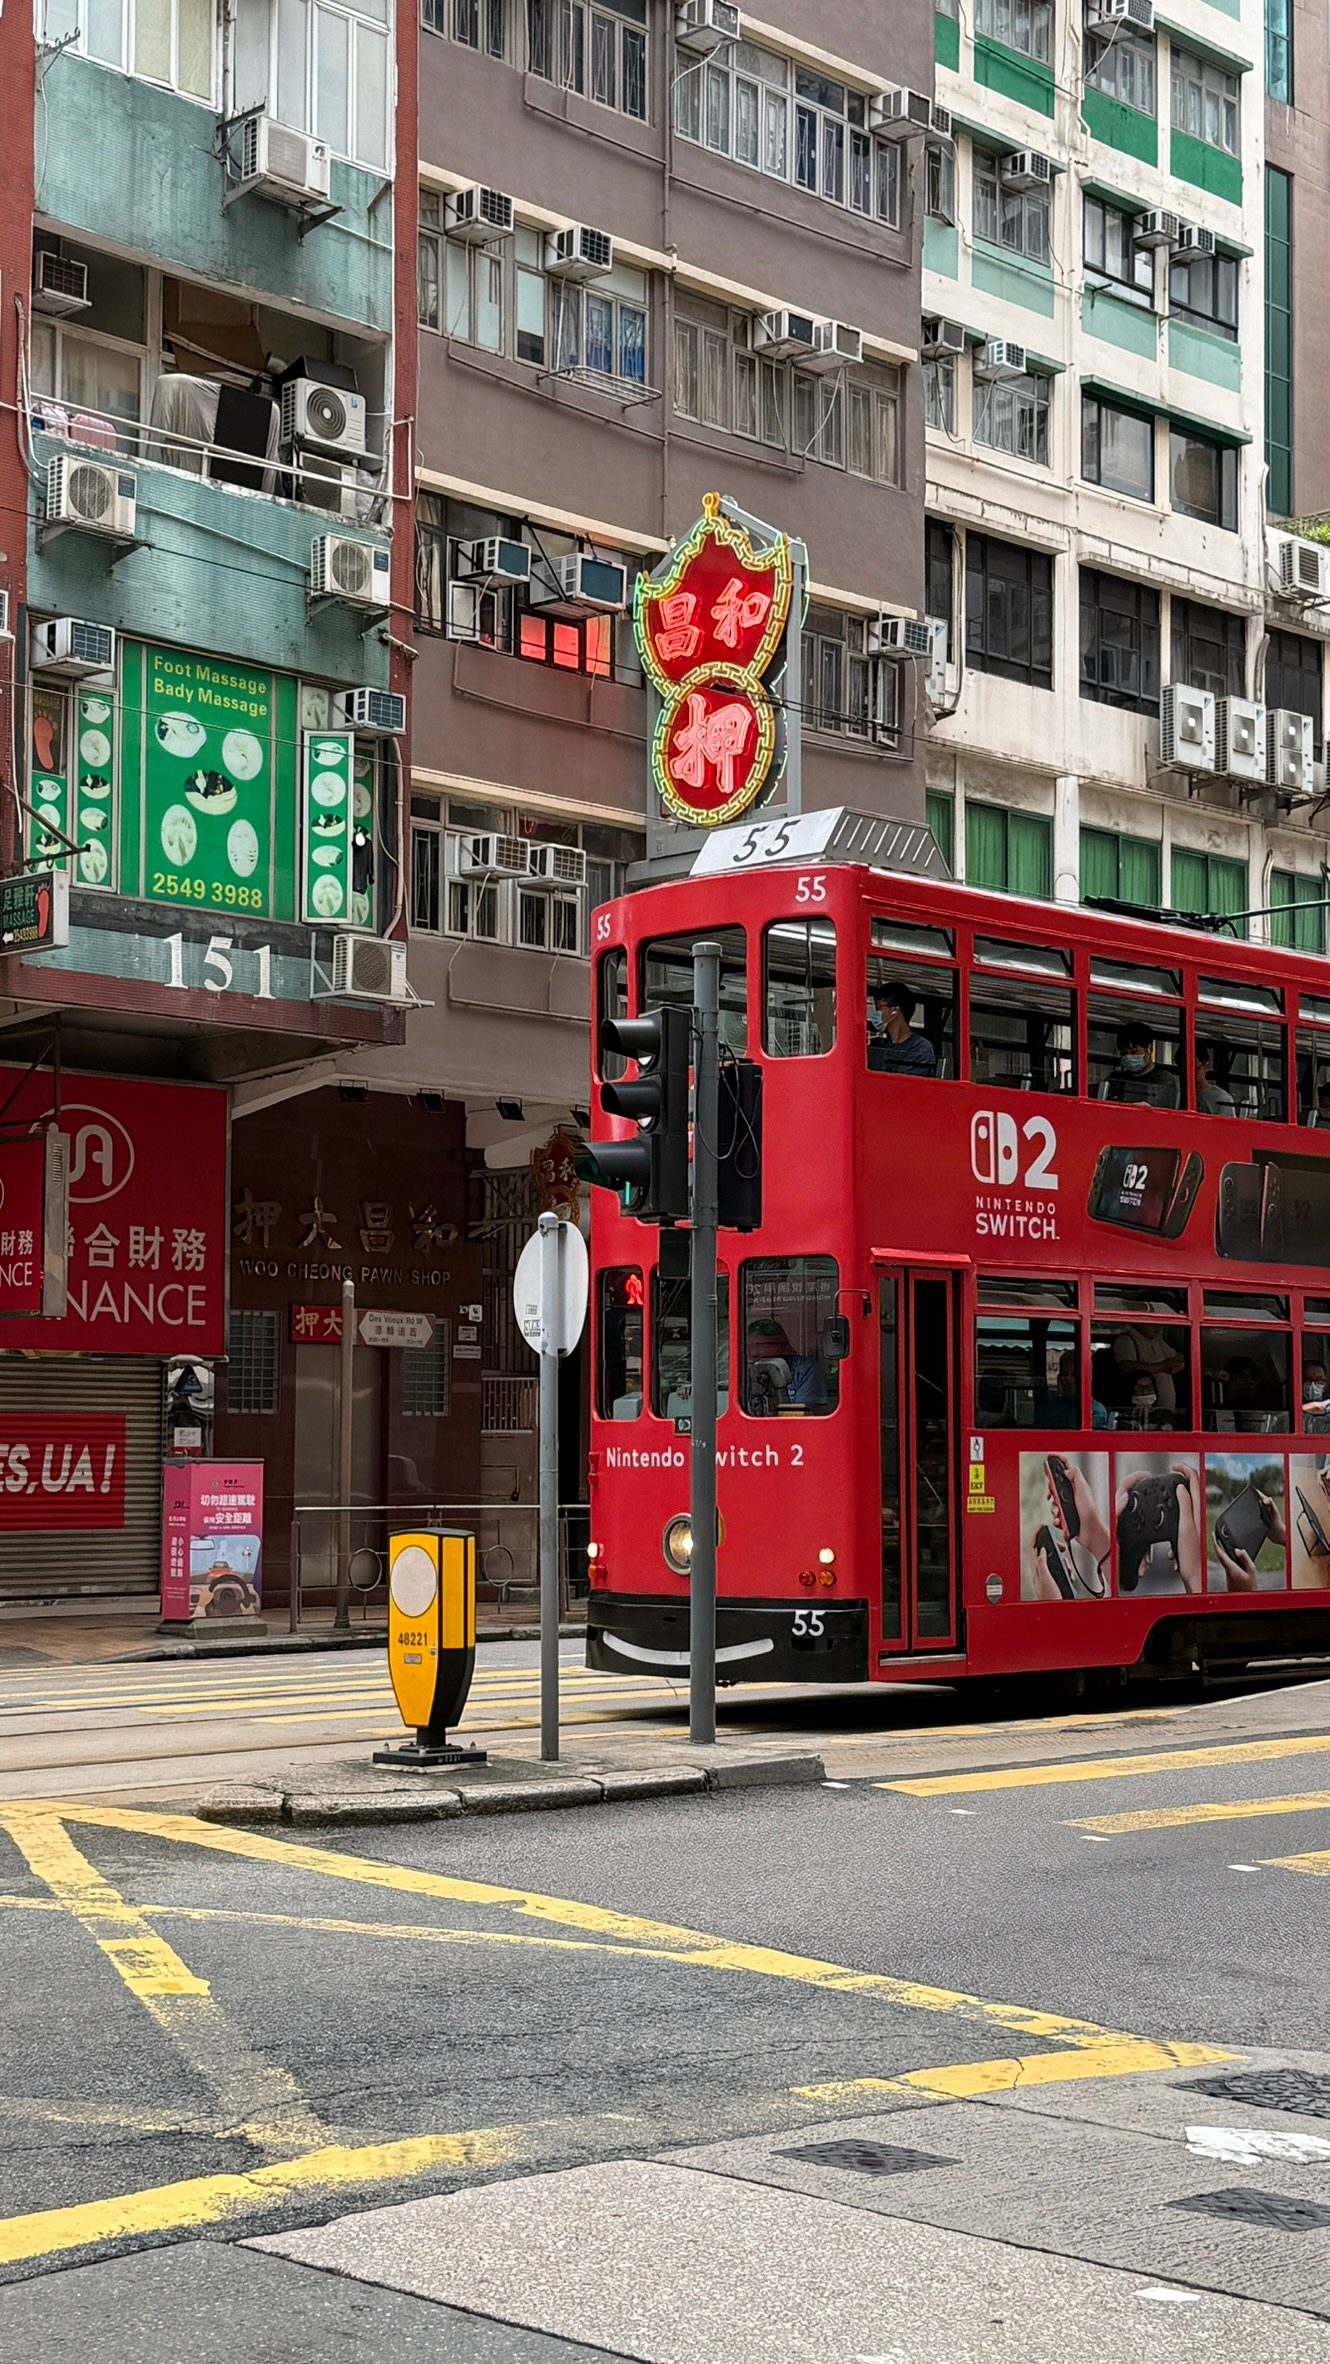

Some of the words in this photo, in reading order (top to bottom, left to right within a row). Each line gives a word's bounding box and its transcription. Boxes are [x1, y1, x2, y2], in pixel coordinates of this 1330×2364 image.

[154, 656, 191, 679] Foot
[196, 664, 267, 695] Massage
[154, 678, 193, 702] Bady
[198, 687, 267, 717] Massage
[670, 694, 752, 794] 押
[733, 819, 801, 862] 55
[152, 873, 206, 899] 2549
[211, 882, 263, 909] 3988
[795, 876, 827, 903] 55
[597, 913, 611, 941] 55
[163, 932, 277, 1000] 151
[975, 1196, 1057, 1215] NINTENDO
[239, 1259, 279, 1278] WOO
[287, 1263, 352, 1281] CHEONG
[361, 1266, 402, 1284] PAWN
[411, 1269, 451, 1287] SHOP
[605, 1446, 685, 1469] Nintendo
[714, 1444, 779, 1468] witch
[790, 1444, 804, 1467] 2
[791, 1609, 825, 1638] 55
[398, 1632, 428, 1647] 48221
